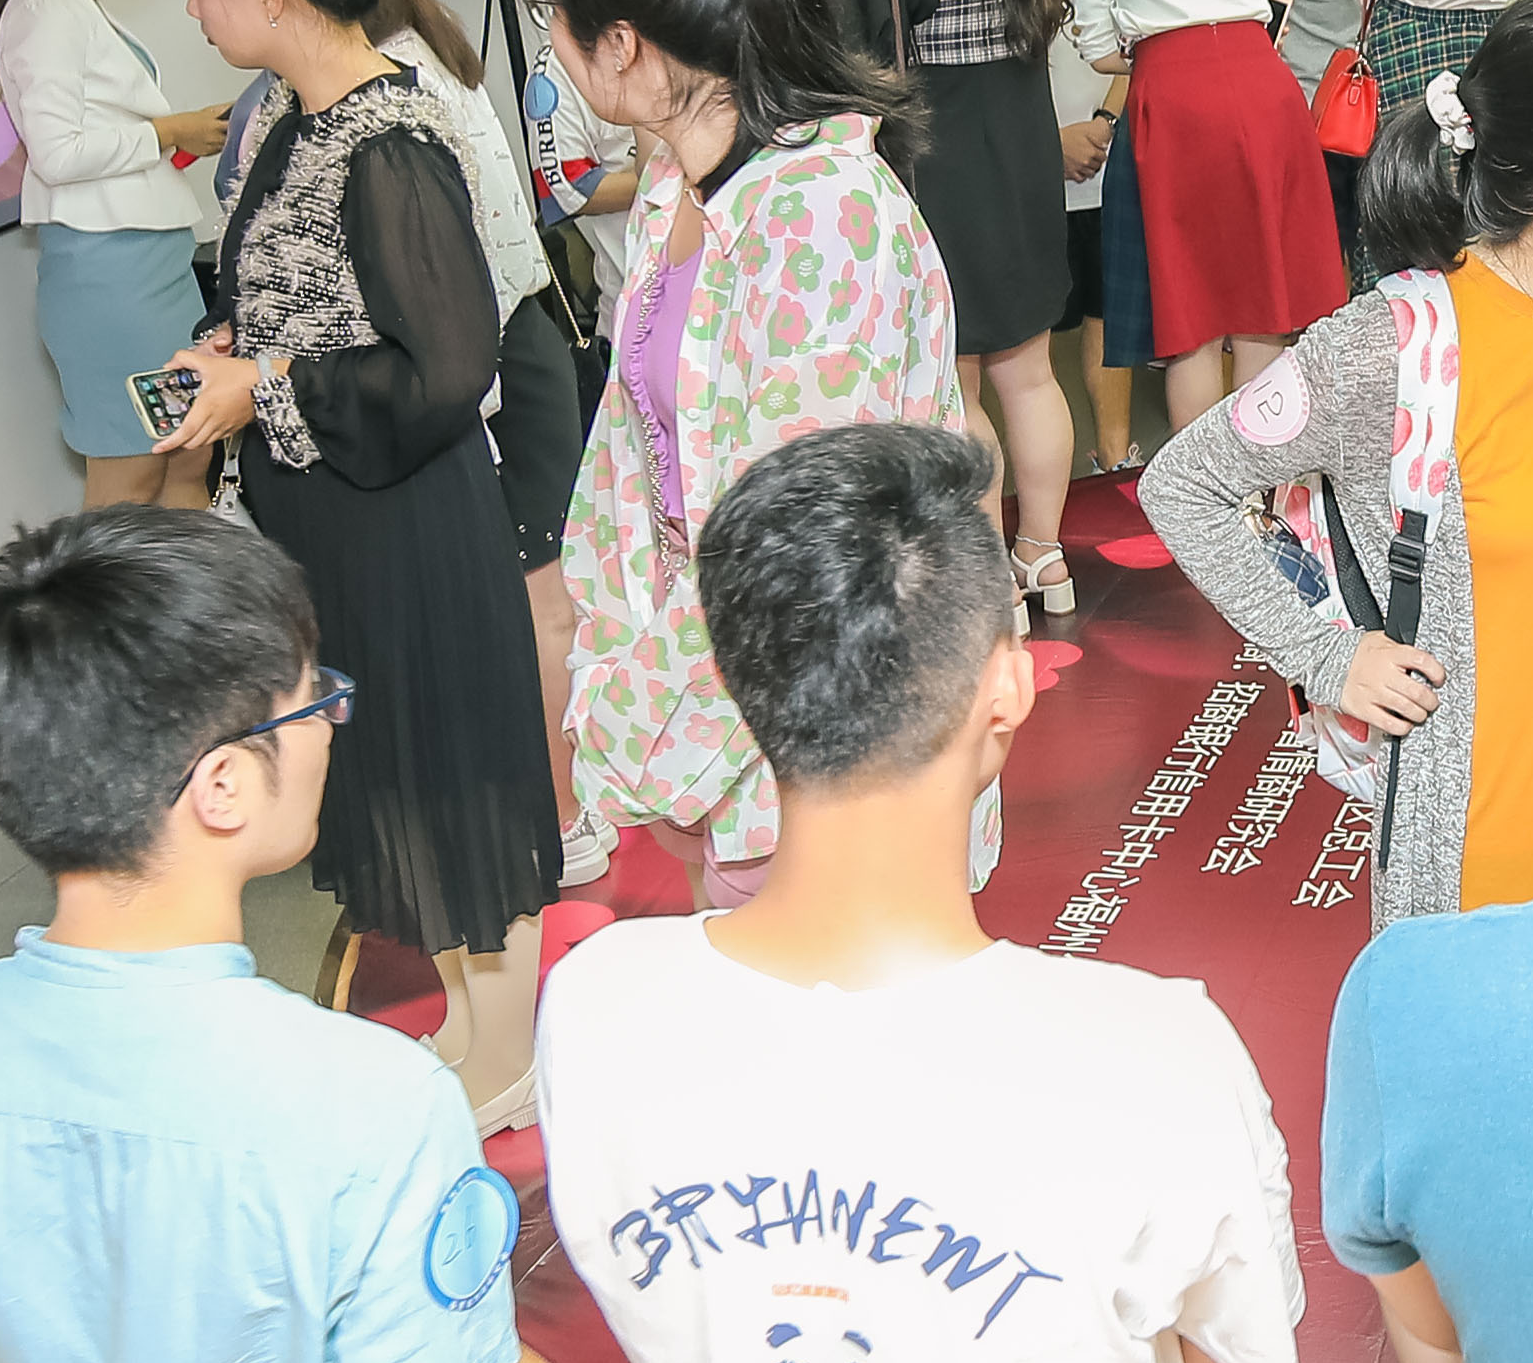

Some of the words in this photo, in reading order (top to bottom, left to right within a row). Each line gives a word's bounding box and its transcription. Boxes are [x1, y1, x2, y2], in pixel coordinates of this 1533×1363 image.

[1038, 642, 1267, 958] 商：招商银行信用卡中心福州
[1291, 795, 1376, 910] 区总工会
